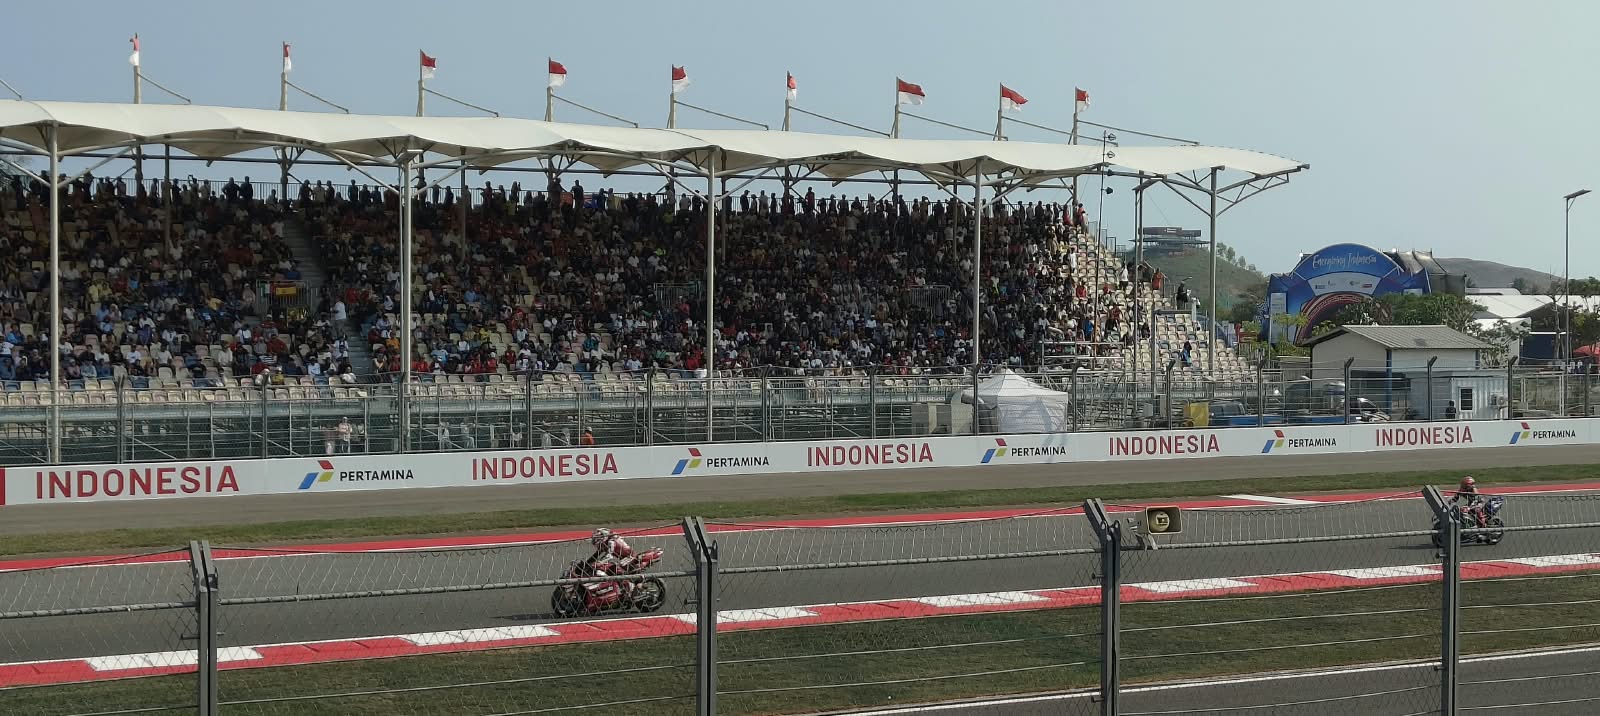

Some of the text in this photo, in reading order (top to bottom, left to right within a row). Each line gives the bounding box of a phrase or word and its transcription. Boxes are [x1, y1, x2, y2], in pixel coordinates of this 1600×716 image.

[1288, 437, 1337, 448] PERTAMINA
[1375, 425, 1474, 447] INDONESIA
[1531, 429, 1577, 439] PERTAMINA
[1011, 446, 1067, 457] PERTAMINA
[1109, 433, 1220, 456] INDONESIA
[706, 455, 770, 469] PERTAMINA
[807, 442, 934, 467] INDONESIA
[339, 468, 415, 482] PERTAMINA
[472, 452, 619, 481] INDONESIA
[36, 465, 240, 499] INDONESIA
